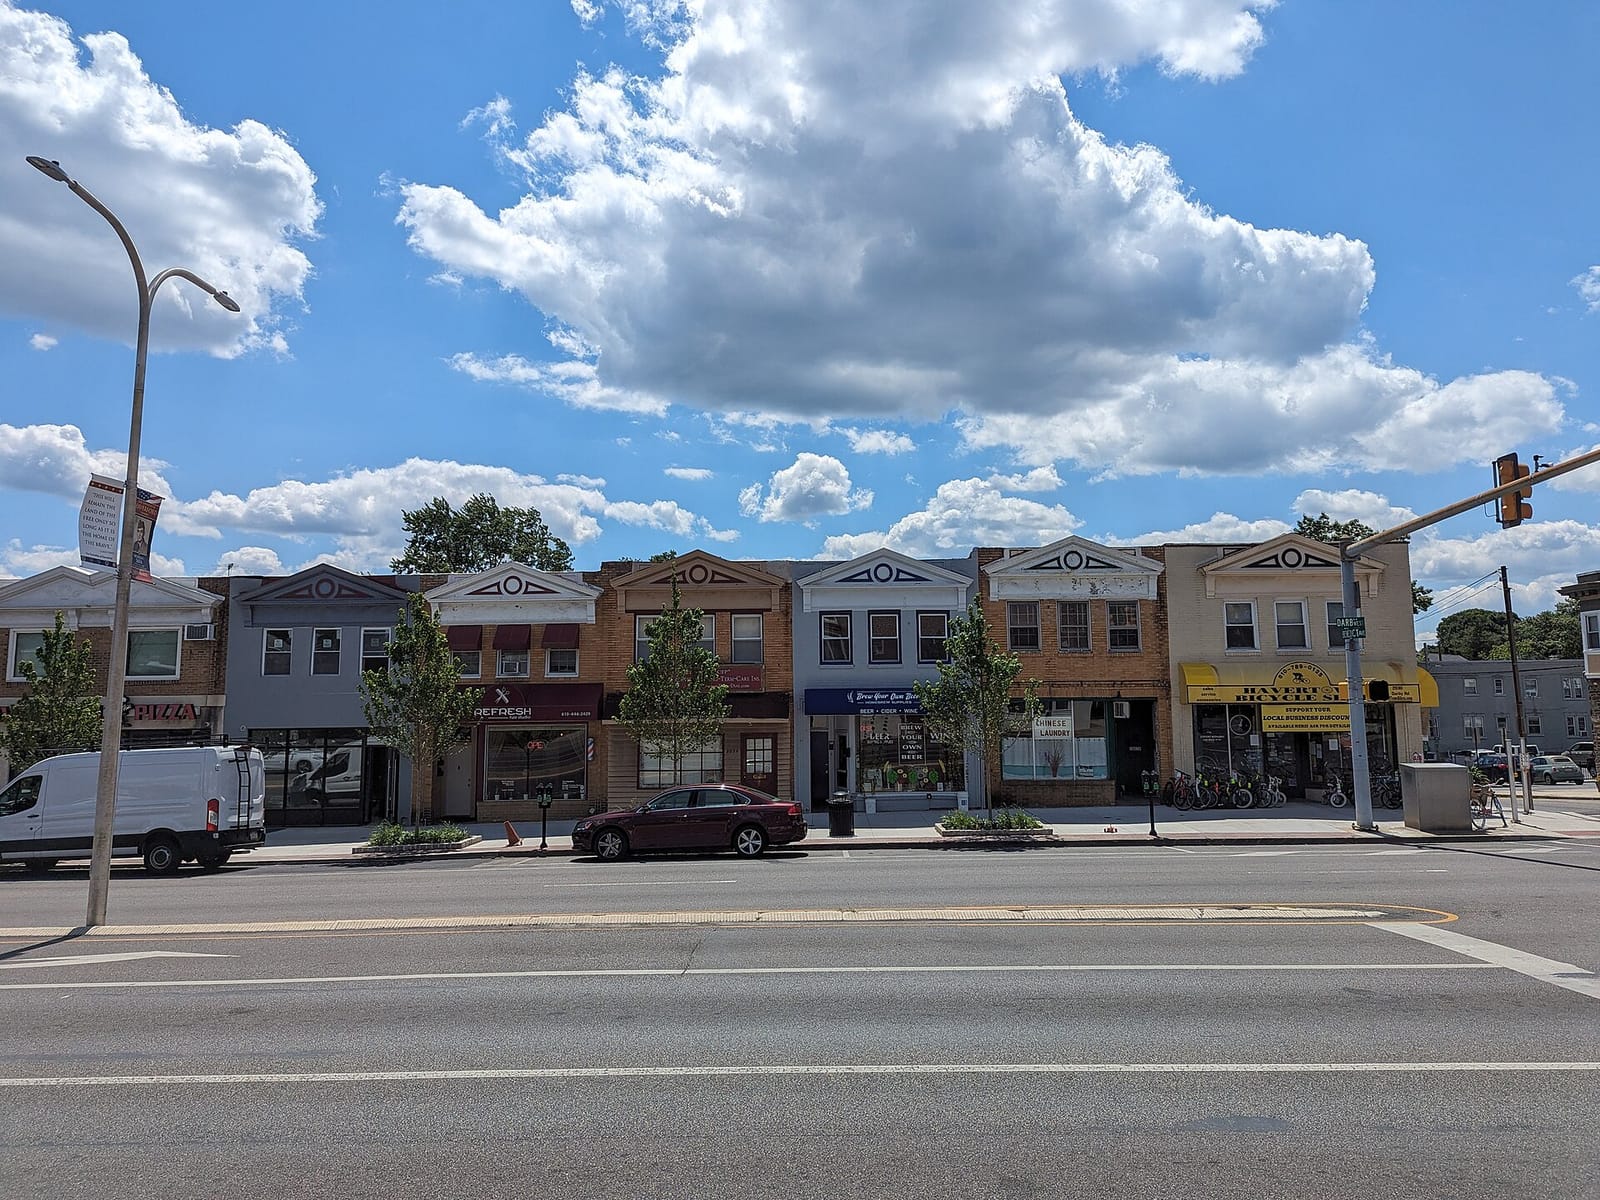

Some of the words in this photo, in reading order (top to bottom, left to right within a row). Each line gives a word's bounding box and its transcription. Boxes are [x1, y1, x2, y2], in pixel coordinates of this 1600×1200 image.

[1243, 687, 1340, 695] HAVERTO
[857, 693, 874, 701] Brew
[874, 692, 889, 701] Your
[890, 692, 905, 701] Own
[134, 703, 198, 721] PIZZA
[473, 707, 532, 717] REFRESH
[1035, 719, 1067, 727] CHINESE
[1040, 729, 1071, 737] LAUNDRY
